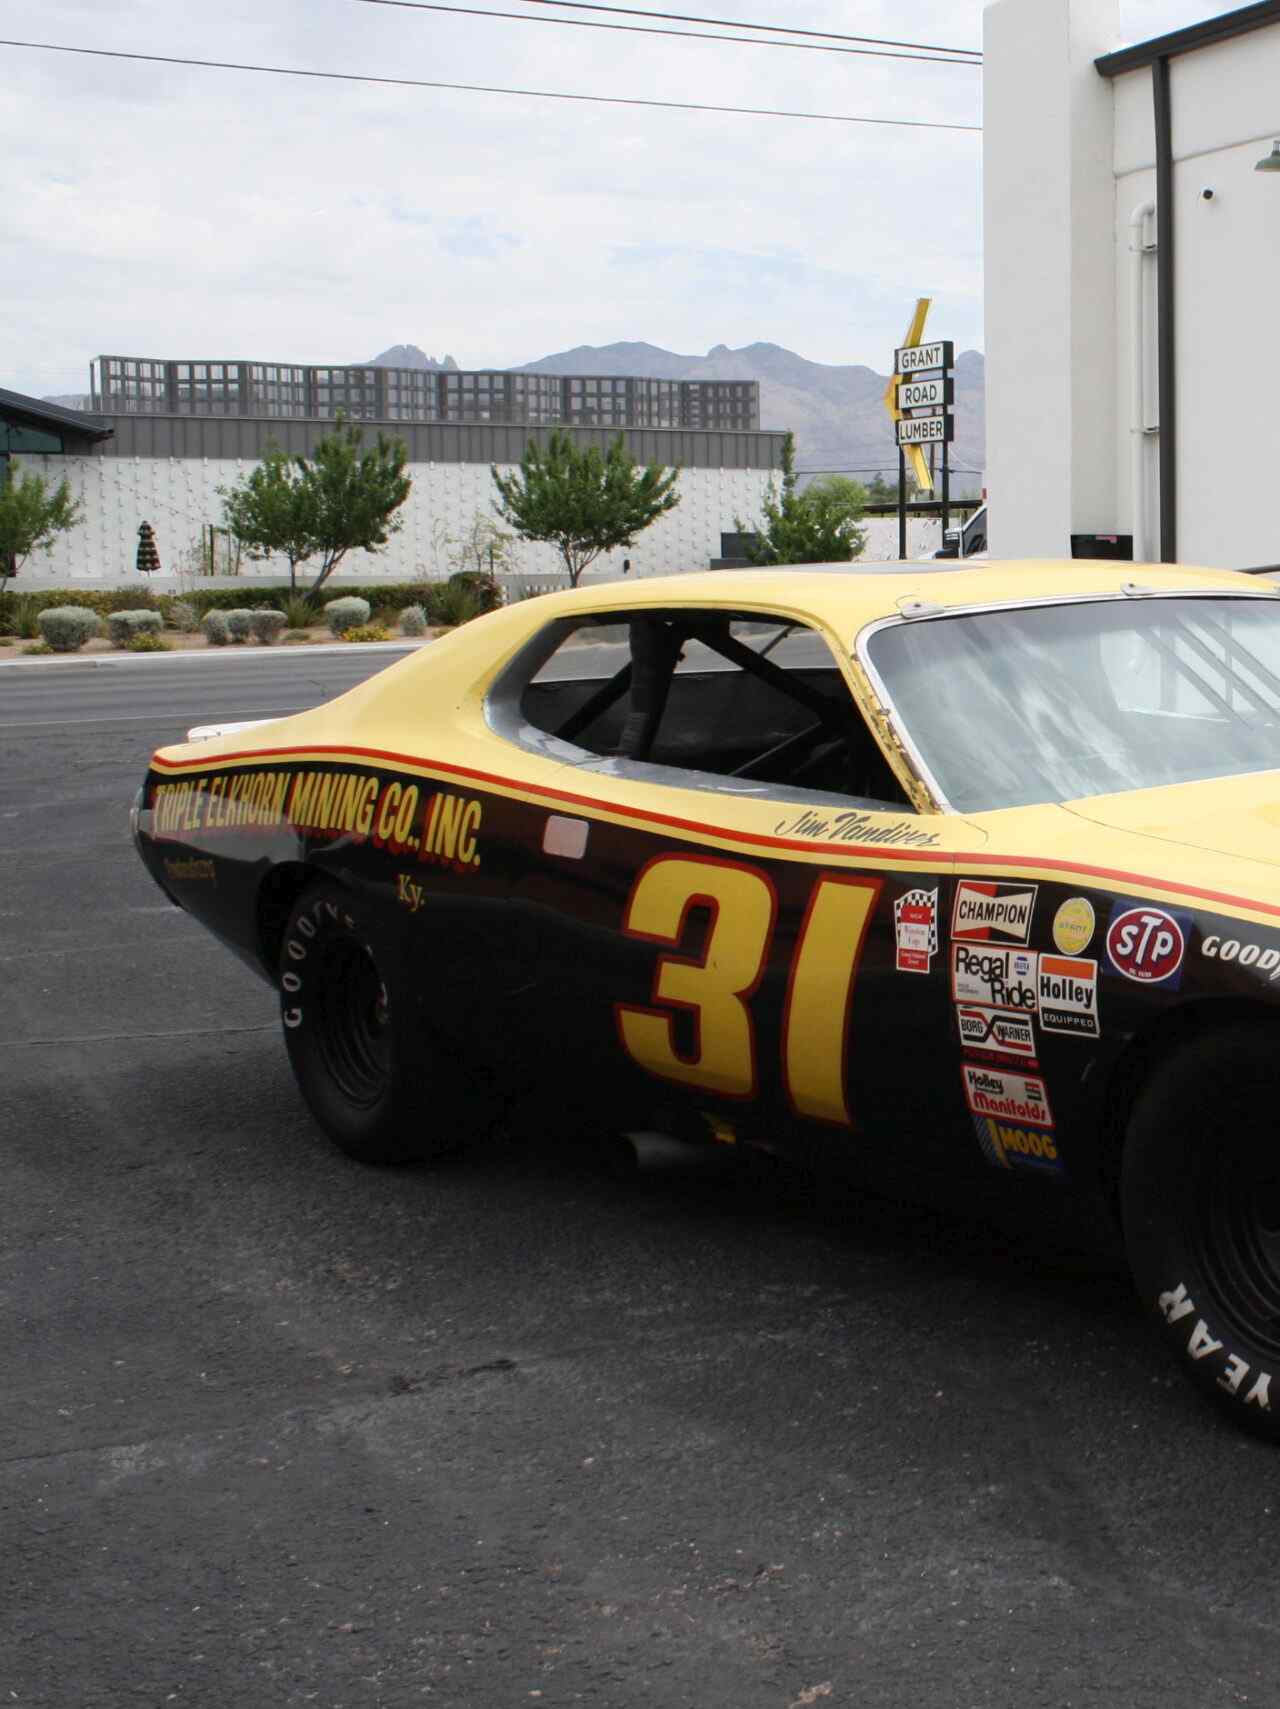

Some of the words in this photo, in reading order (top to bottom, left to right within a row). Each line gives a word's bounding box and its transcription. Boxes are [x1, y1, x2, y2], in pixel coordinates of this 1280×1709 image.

[901, 347, 941, 369] GRANT
[905, 384, 938, 405] ROAD
[900, 420, 943, 441] LUMBER
[154, 778, 207, 834] TRIPLE
[205, 771, 291, 827] ELKHORN
[288, 771, 380, 836] MINING
[774, 810, 830, 840] Jim
[958, 899, 1028, 925] CHAMPION
[1116, 915, 1174, 965] STP
[956, 946, 1010, 983] Regal
[614, 853, 886, 1128] 31
[991, 979, 1036, 1009] Ride
[1040, 975, 1094, 1009] Holley
[960, 1018, 984, 1034] BORG
[996, 1023, 1032, 1042] WARNER
[1043, 1012, 1095, 1028] EQUIPPED
[999, 1126, 1057, 1160] MOOG
